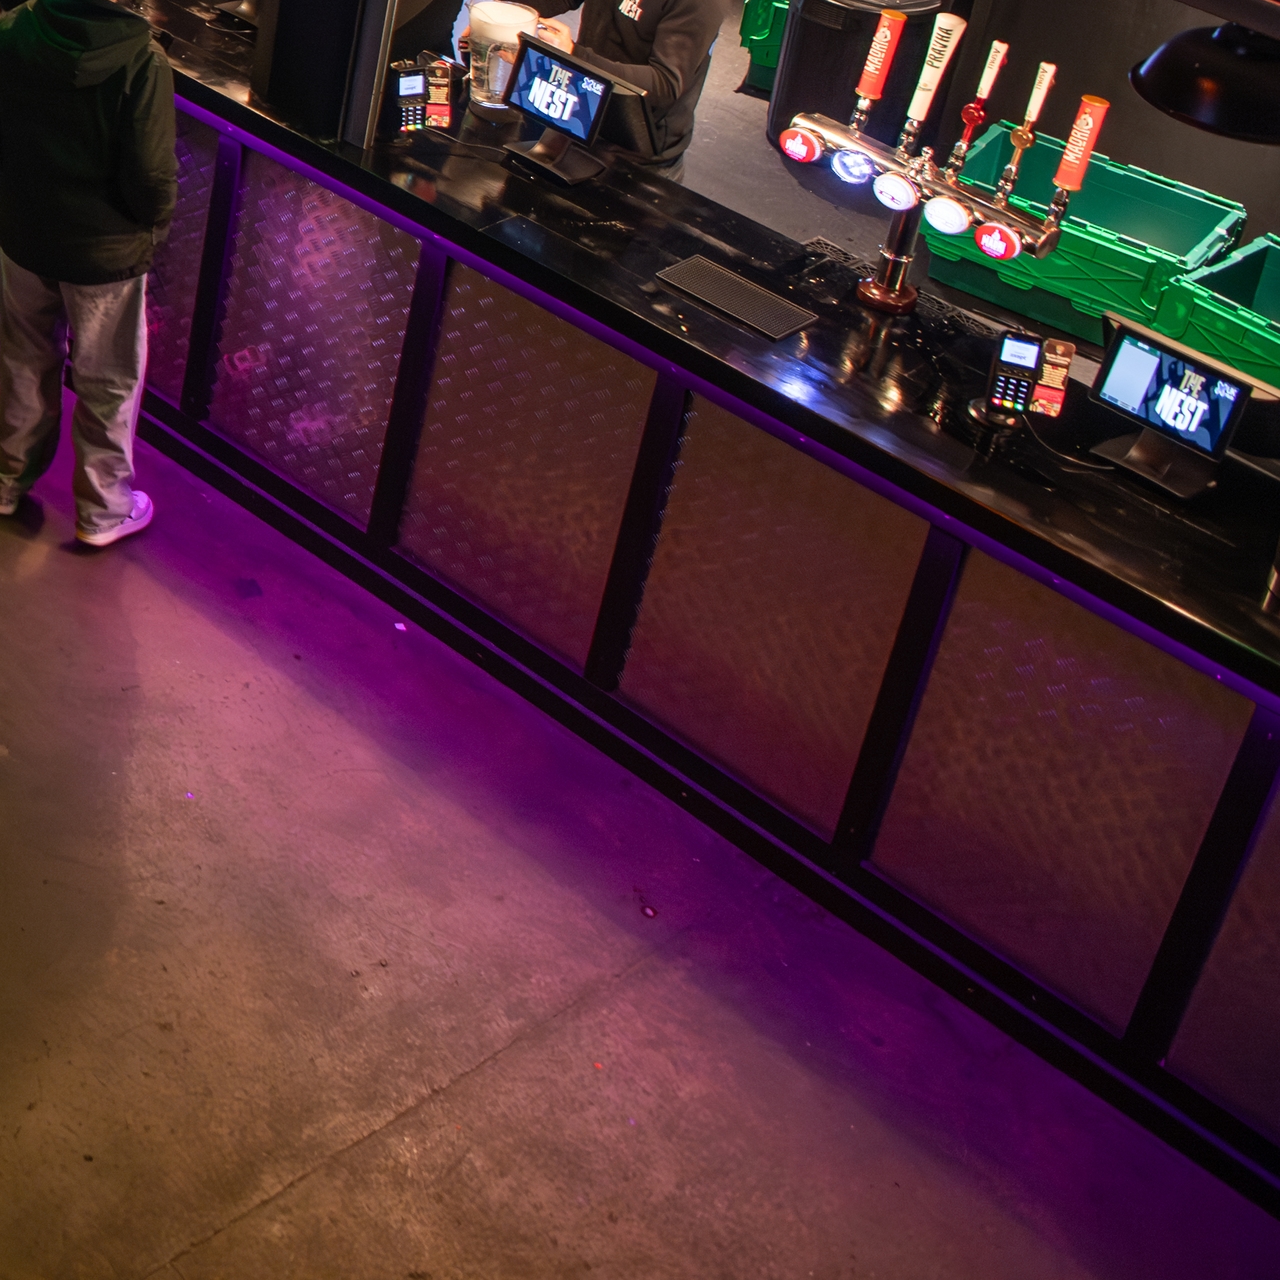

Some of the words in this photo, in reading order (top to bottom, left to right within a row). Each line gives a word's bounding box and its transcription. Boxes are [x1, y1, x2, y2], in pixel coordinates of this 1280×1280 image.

[863, 36, 889, 75] MADRI
[926, 26, 954, 70] PRAVHA
[528, 76, 579, 121] NEST
[548, 64, 573, 91] THE
[1063, 123, 1091, 165] MADRI
[1179, 369, 1206, 399] THE
[1154, 384, 1209, 432] NEST
